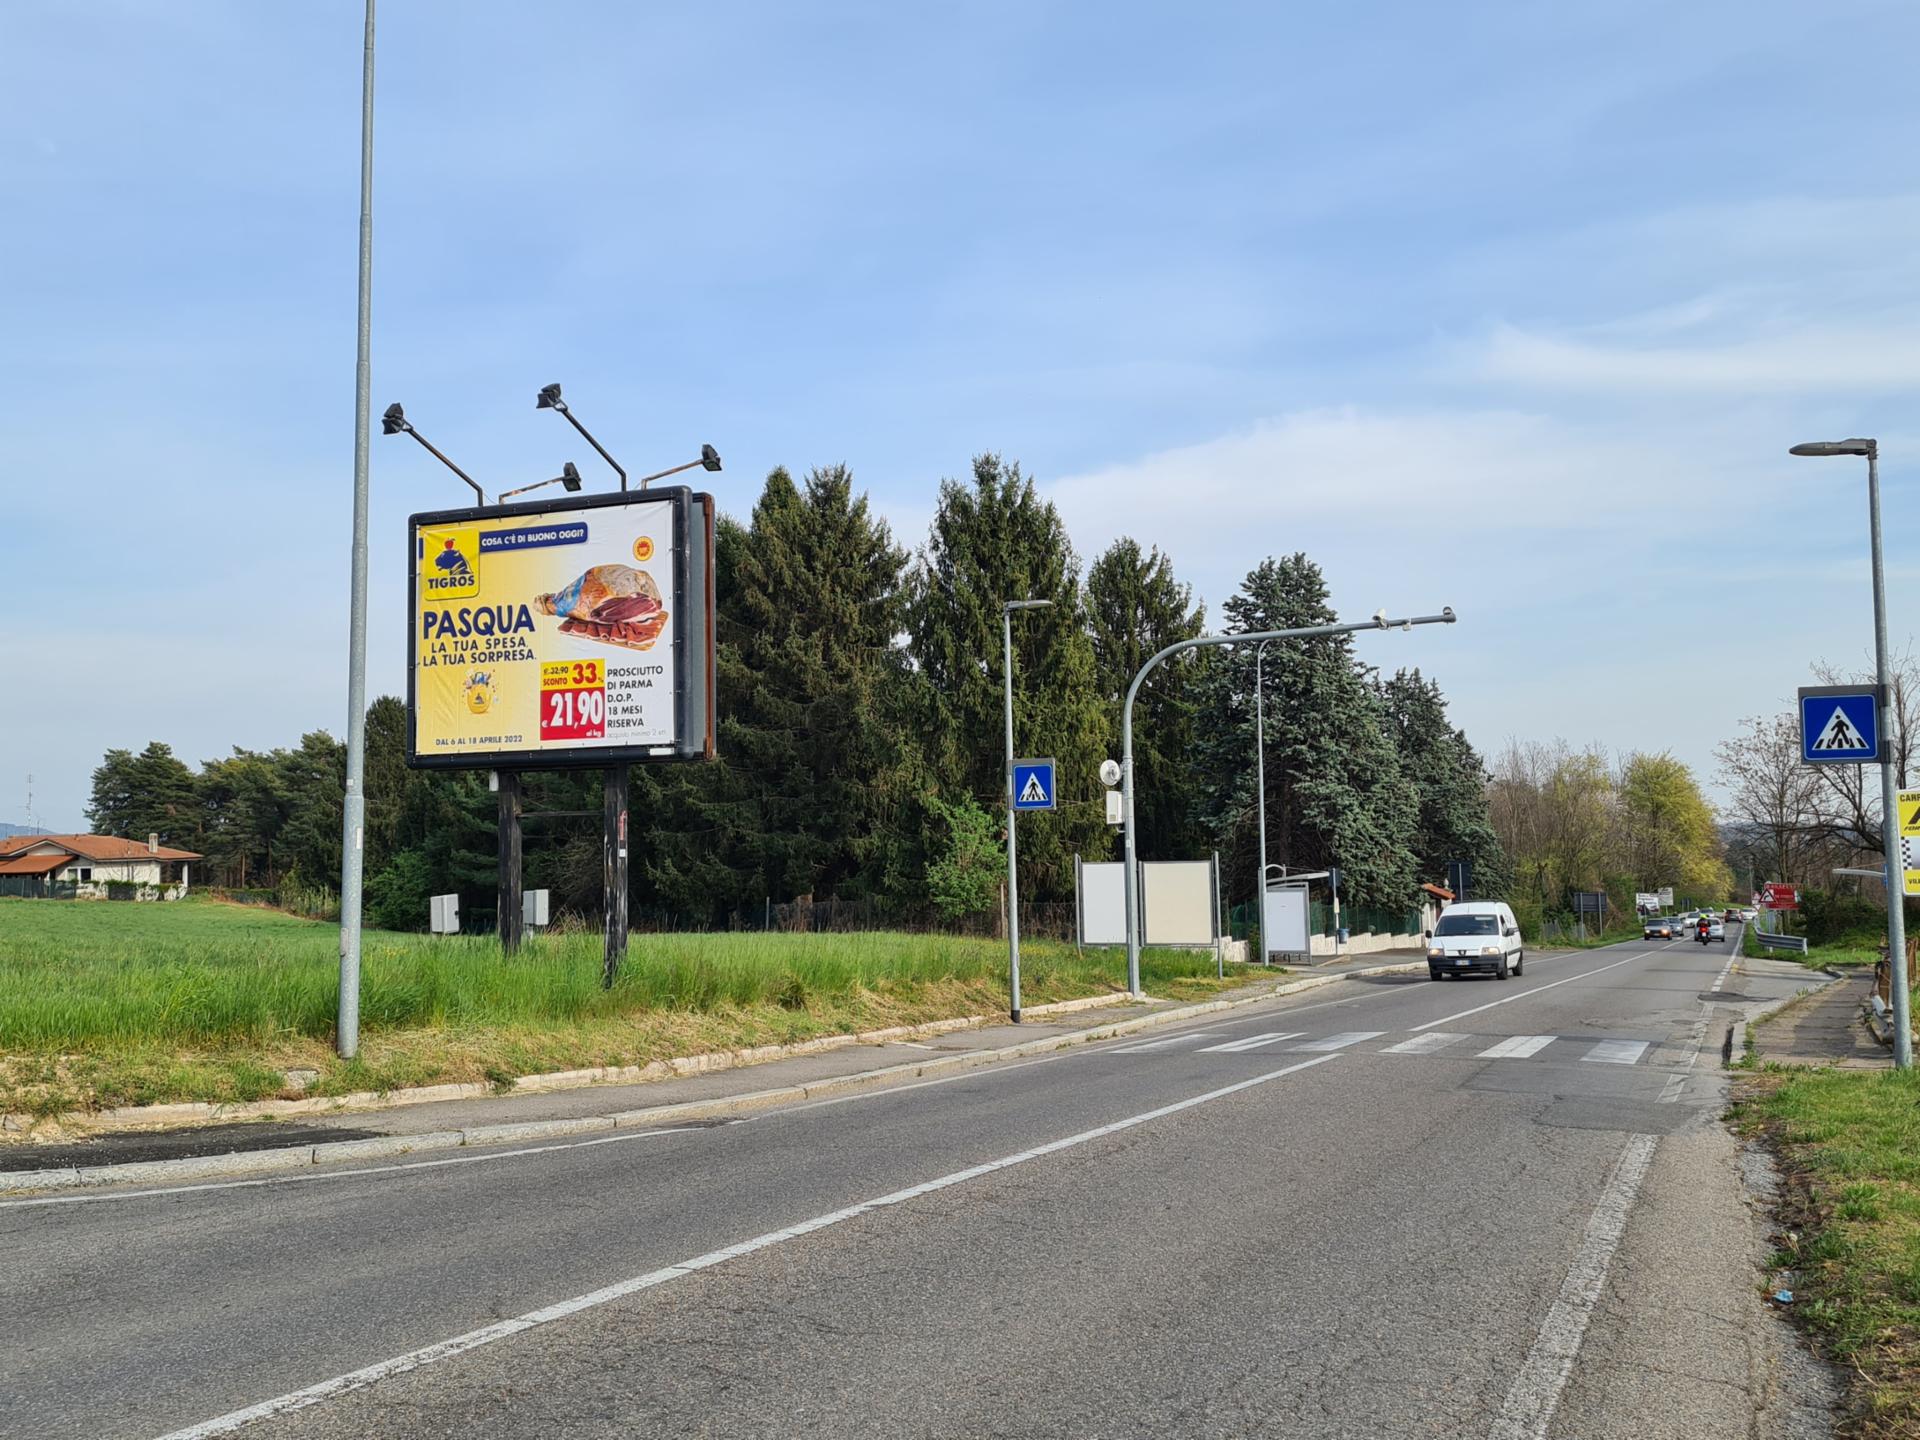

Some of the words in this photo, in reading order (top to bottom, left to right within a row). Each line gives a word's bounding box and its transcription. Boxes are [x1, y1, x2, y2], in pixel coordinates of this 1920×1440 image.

[481, 537, 503, 547] COSA
[504, 533, 516, 545] C'È
[517, 534, 526, 544] DI
[527, 531, 557, 543] BUONO
[558, 528, 585, 540] OGGI?
[428, 575, 475, 590] TIGROS
[423, 604, 536, 640] PASQUA
[431, 642, 447, 654] LA
[453, 639, 479, 652] TUA
[423, 655, 438, 667] LA
[442, 653, 466, 666] TUA
[607, 665, 664, 678] PROSCIUTTO
[543, 677, 568, 687] SCONTO
[607, 681, 616, 690] DI
[619, 679, 653, 690] PARMA
[607, 693, 634, 703] D.O.P.
[608, 706, 618, 715] 18
[621, 705, 643, 715] MESI
[607, 718, 645, 728] RISERVA
[435, 738, 449, 746] DAL
[457, 737, 466, 745] AL
[479, 735, 502, 744] APRILE
[504, 734, 523, 743] 2022
